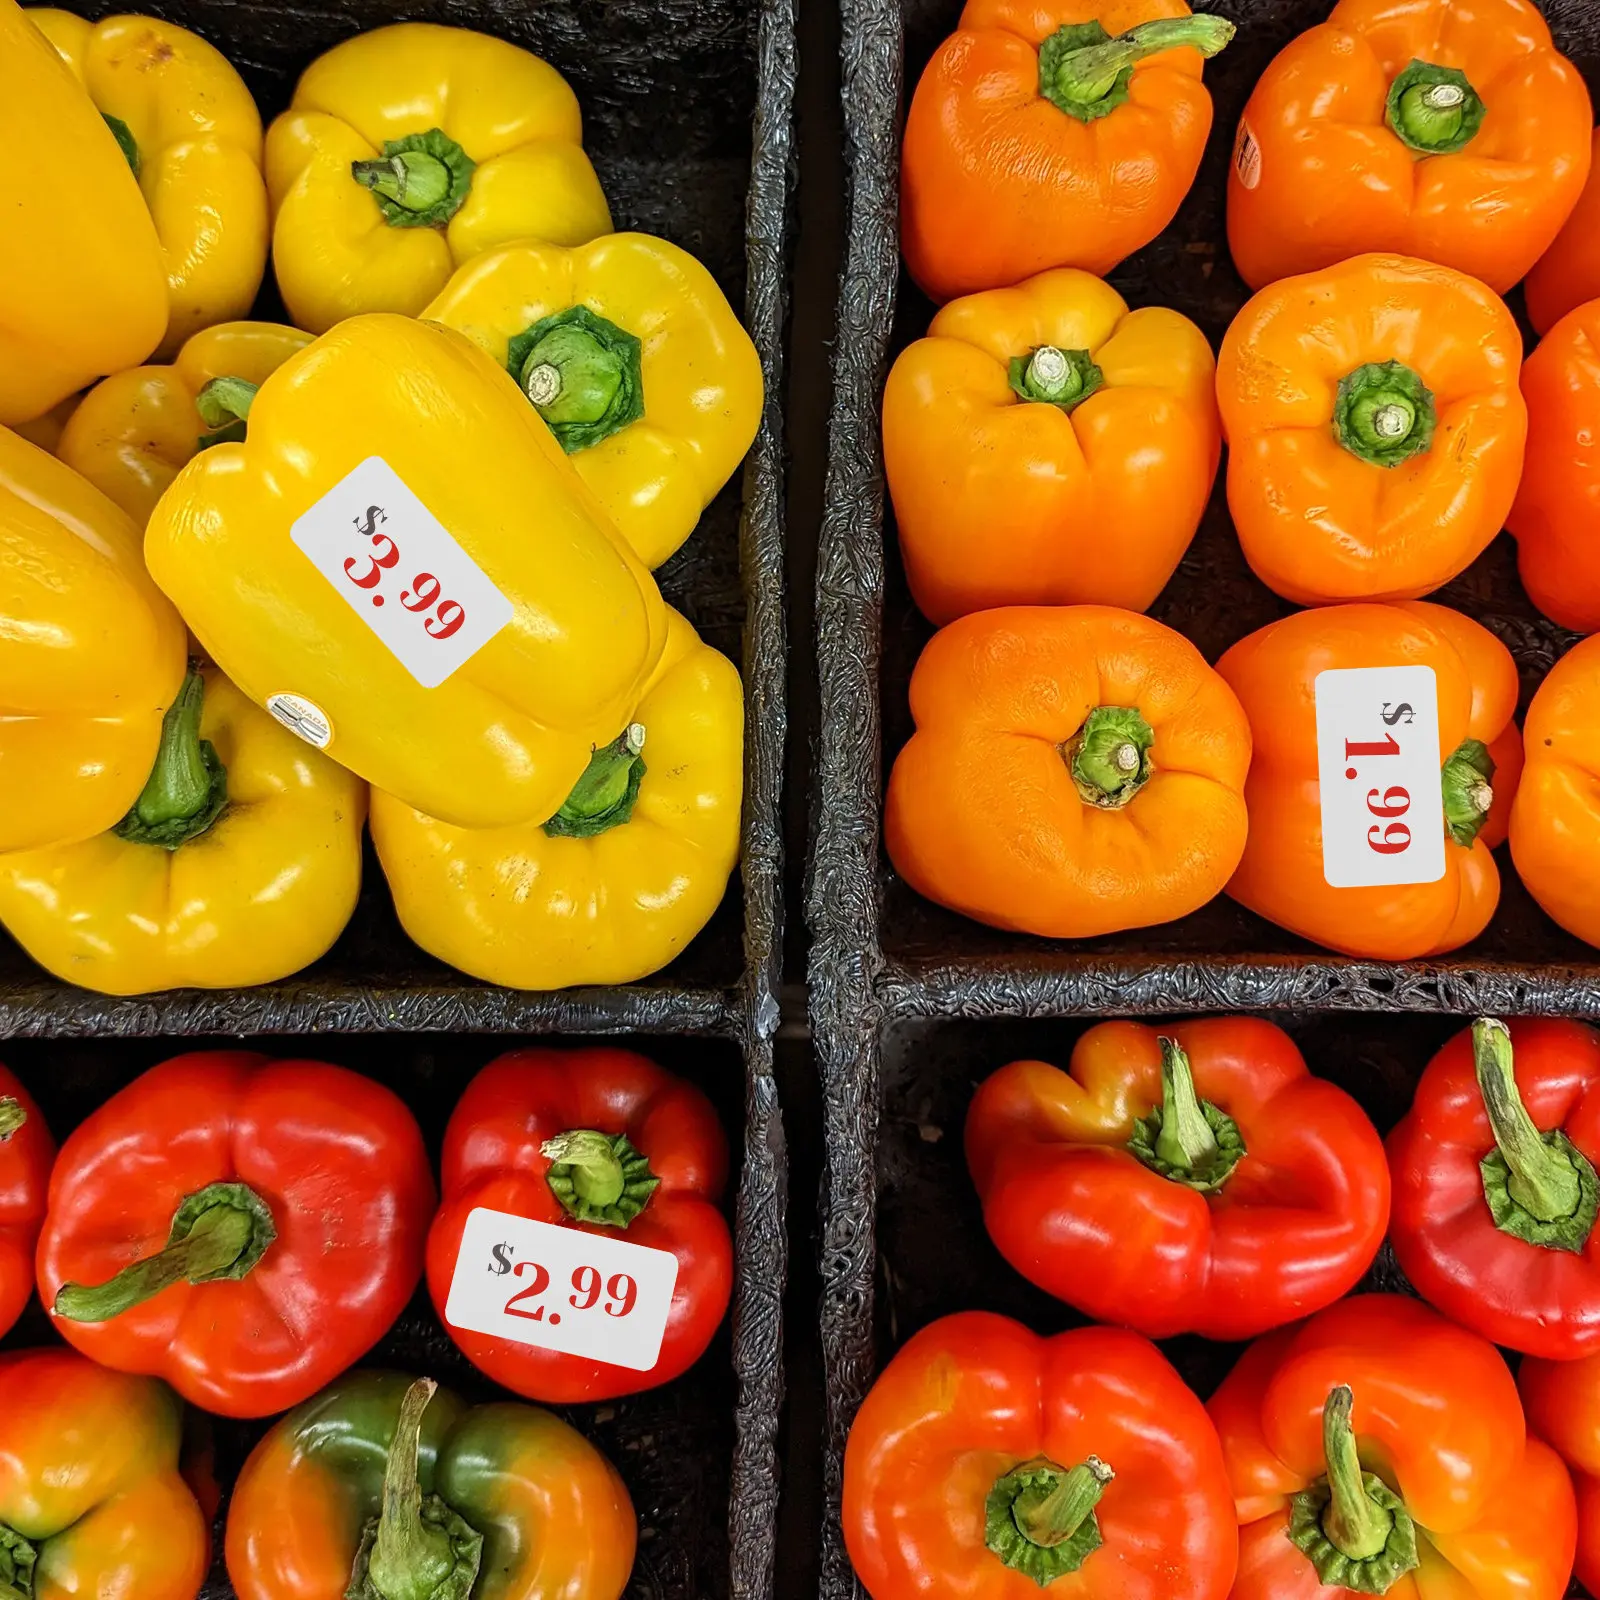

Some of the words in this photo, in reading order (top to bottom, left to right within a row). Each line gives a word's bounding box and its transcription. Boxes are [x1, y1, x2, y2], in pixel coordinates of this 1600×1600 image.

[344, 506, 465, 639] $3.99
[283, 695, 328, 730] CANADA
[1344, 702, 1417, 854] $1.99
[487, 1241, 638, 1325] $2.99
